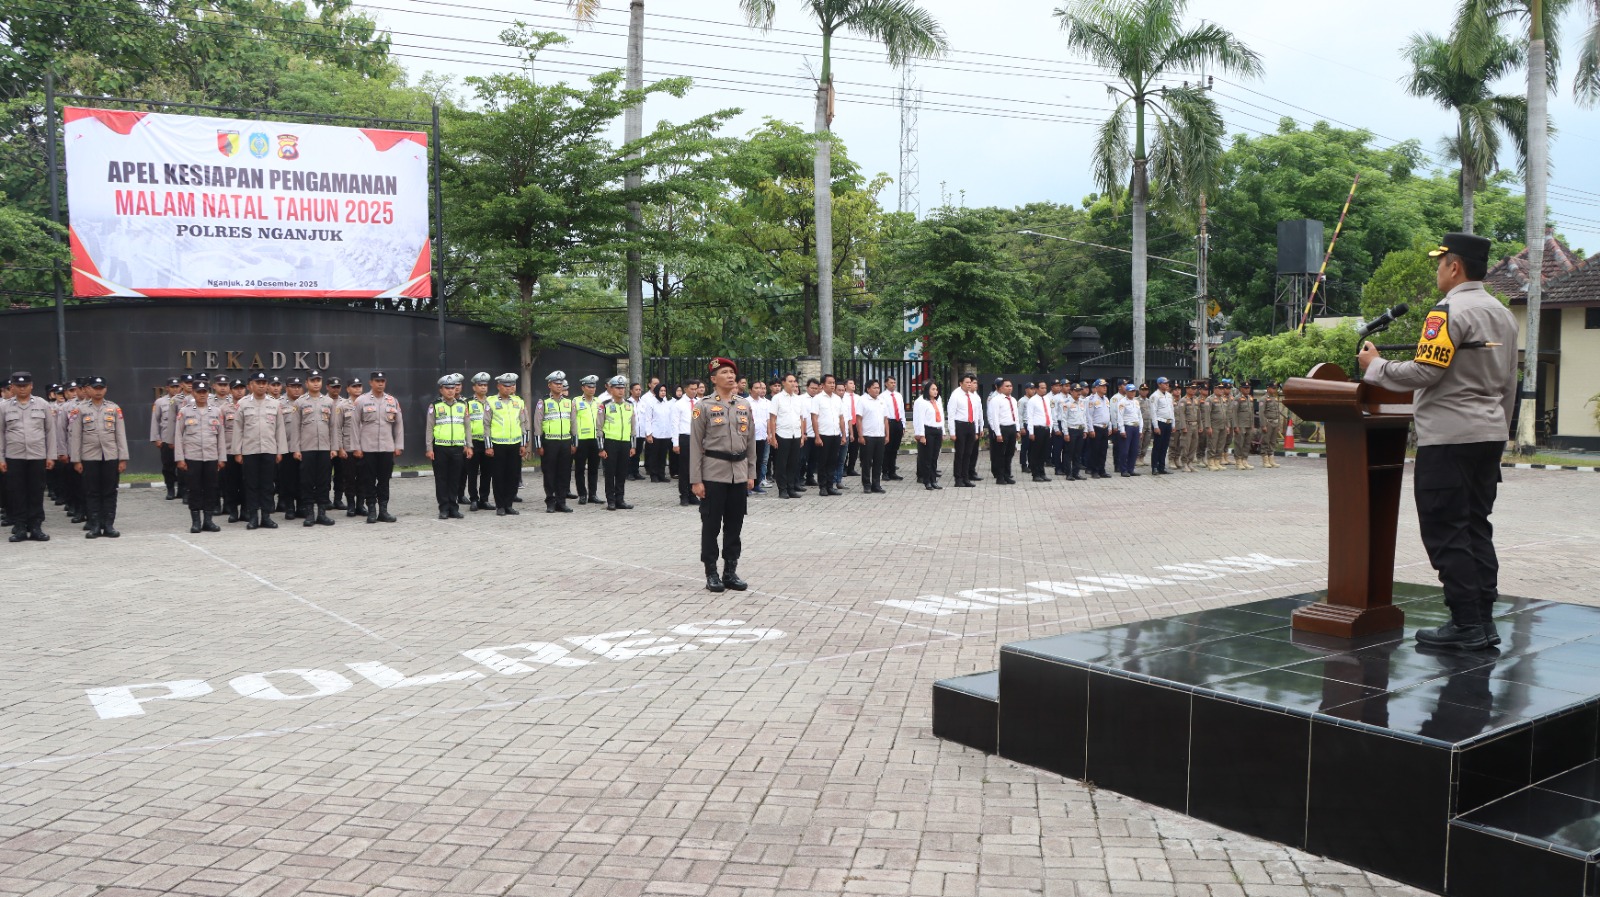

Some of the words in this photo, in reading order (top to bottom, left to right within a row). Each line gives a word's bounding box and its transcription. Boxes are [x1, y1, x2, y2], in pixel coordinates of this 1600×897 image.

[107, 160, 159, 184] APEL
[163, 163, 264, 189] KESIAPAN
[269, 169, 397, 196] PENGAMANAN
[115, 189, 196, 217] MALAM
[202, 192, 268, 220] NATAL
[273, 196, 339, 223] TAHUN
[345, 199, 394, 225] 2025
[176, 224, 252, 239] POLRES
[257, 227, 343, 241] NGANJUK
[207, 279, 243, 288] Nganjuk,
[245, 279, 255, 287] 24
[257, 279, 297, 288] Desember
[299, 280, 318, 288] 2025
[181, 350, 331, 370] TEKADKU
[1433, 345, 1451, 363] RES
[84, 618, 787, 720] POLRES
